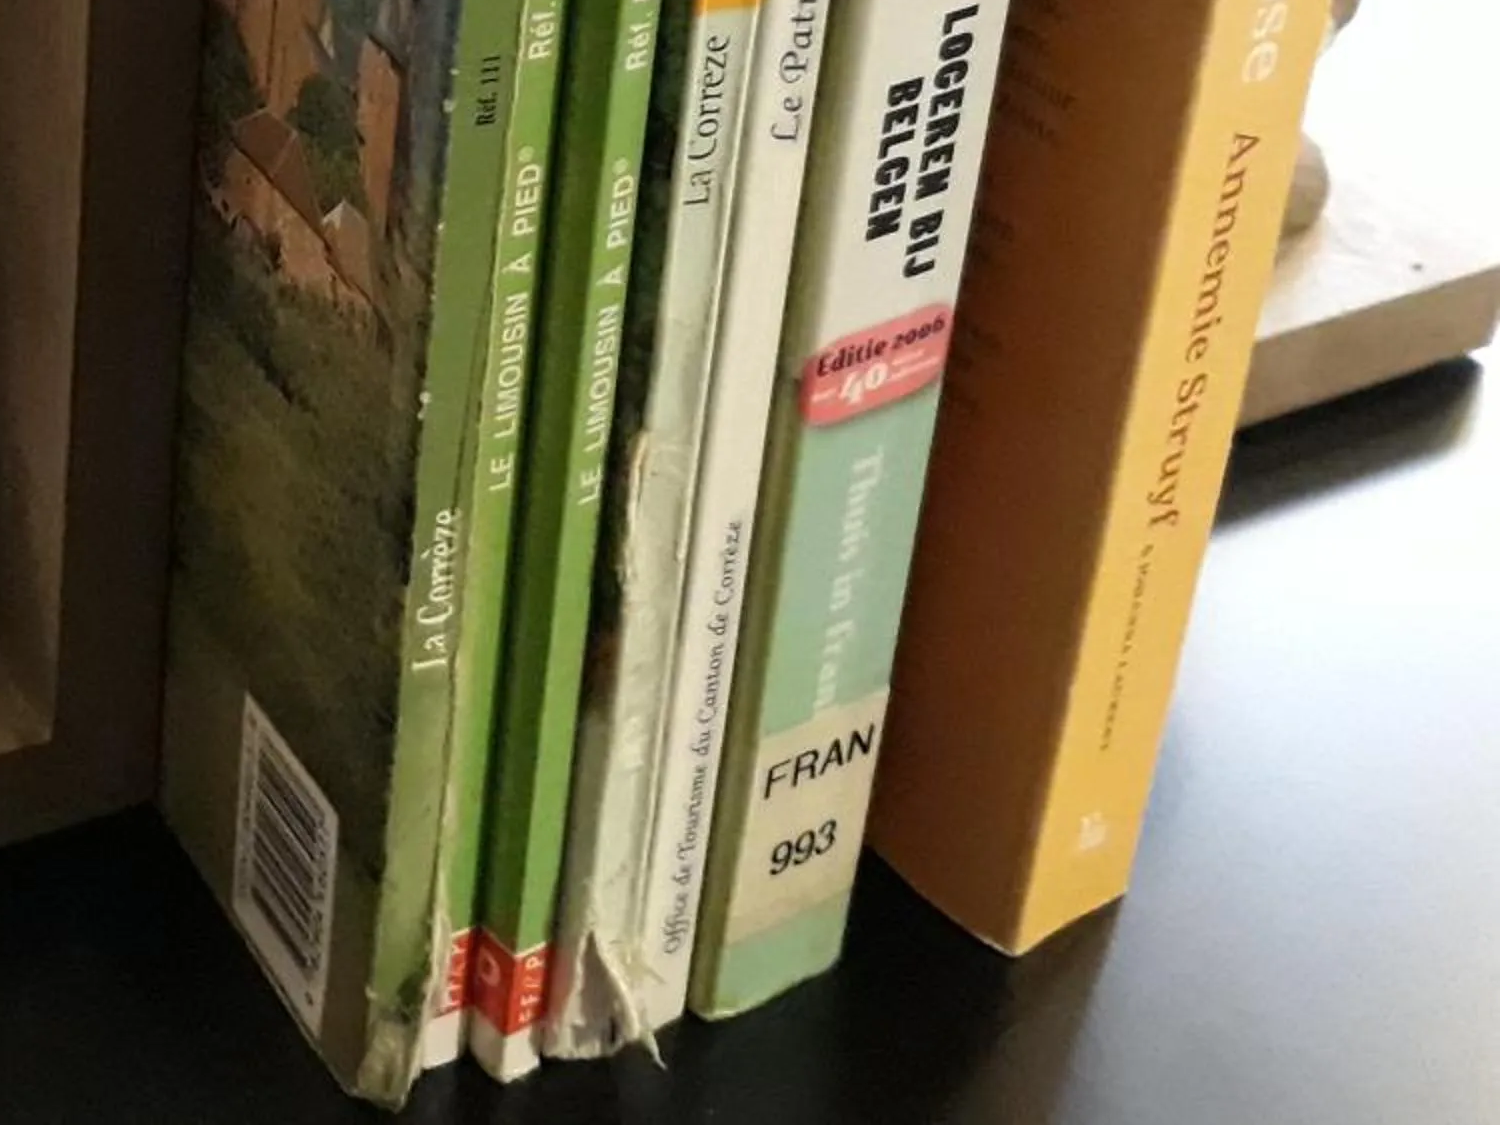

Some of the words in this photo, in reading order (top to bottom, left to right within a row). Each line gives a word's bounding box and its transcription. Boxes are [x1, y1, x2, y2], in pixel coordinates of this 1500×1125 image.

[771, 97, 803, 141] Le
[915, 3, 980, 202] LOGEREN
[683, 170, 713, 205] La
[865, 76, 925, 242] BELGEN
[903, 209, 945, 279] BIJ
[1185, 131, 1261, 364] Annemie
[494, 291, 529, 438] LIMOUSIN
[583, 304, 621, 453] LIMOUSIN
[816, 338, 888, 377] Editie
[891, 314, 946, 350] 2006
[838, 362, 889, 405] 40
[489, 452, 514, 491] LE
[1146, 371, 1210, 529] Struyf
[577, 463, 601, 506] LE
[838, 442, 885, 562] Thuis
[416, 507, 462, 624] Corrèze
[829, 568, 867, 612] in
[707, 612, 729, 636] de
[697, 642, 725, 724] Canton
[691, 730, 712, 756] du
[764, 722, 876, 801] FRAN
[676, 766, 708, 860] Tourisme
[671, 863, 693, 886] de
[769, 818, 838, 877] 993
[664, 892, 691, 954] Office
